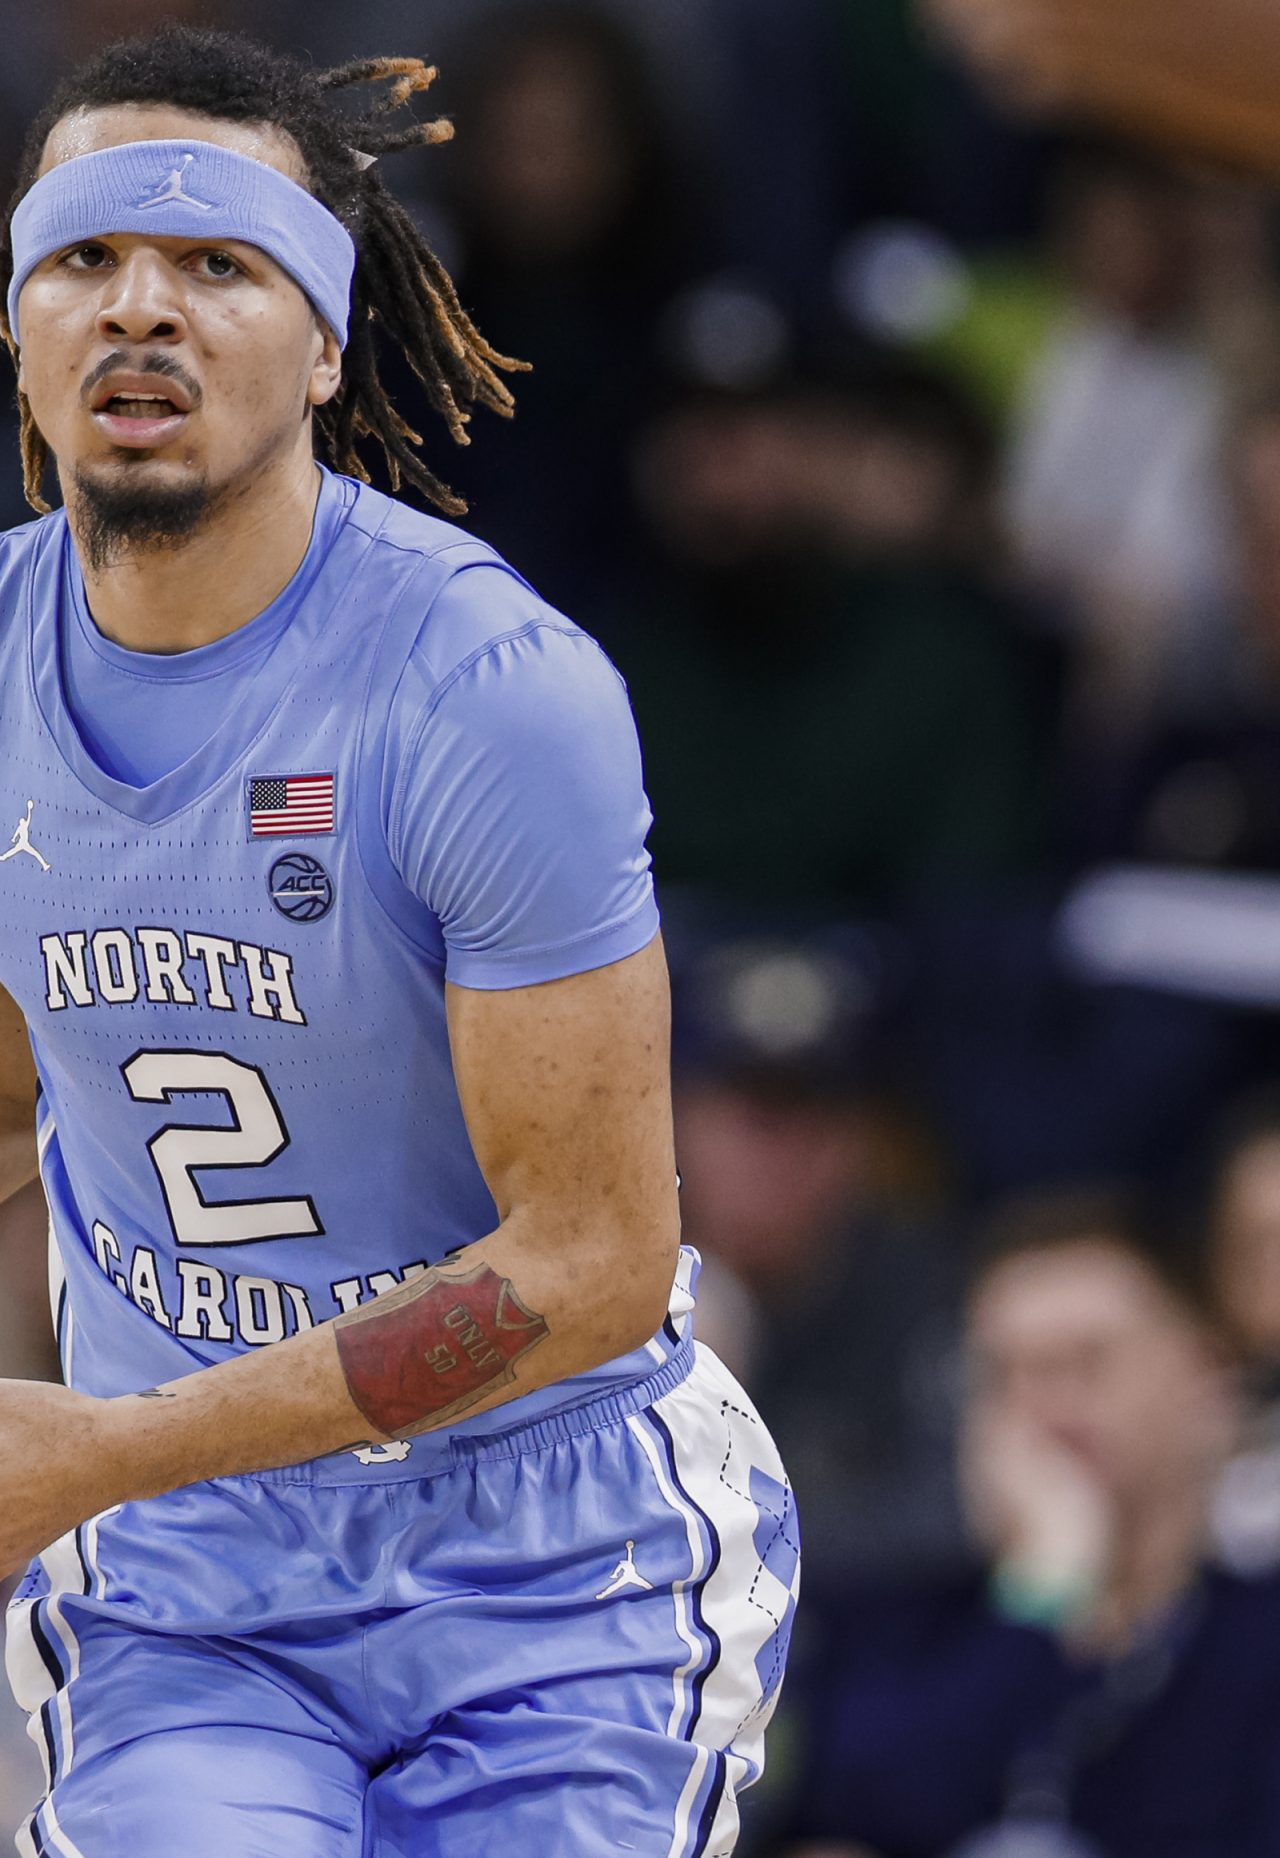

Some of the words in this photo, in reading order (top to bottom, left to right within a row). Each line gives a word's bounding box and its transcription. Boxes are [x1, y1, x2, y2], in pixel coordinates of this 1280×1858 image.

[277, 874, 327, 892] ACC
[39, 926, 308, 1026] NORTH
[120, 1048, 326, 1247] 2
[424, 1344, 457, 1375] 50
[443, 1305, 501, 1369] UNLV
